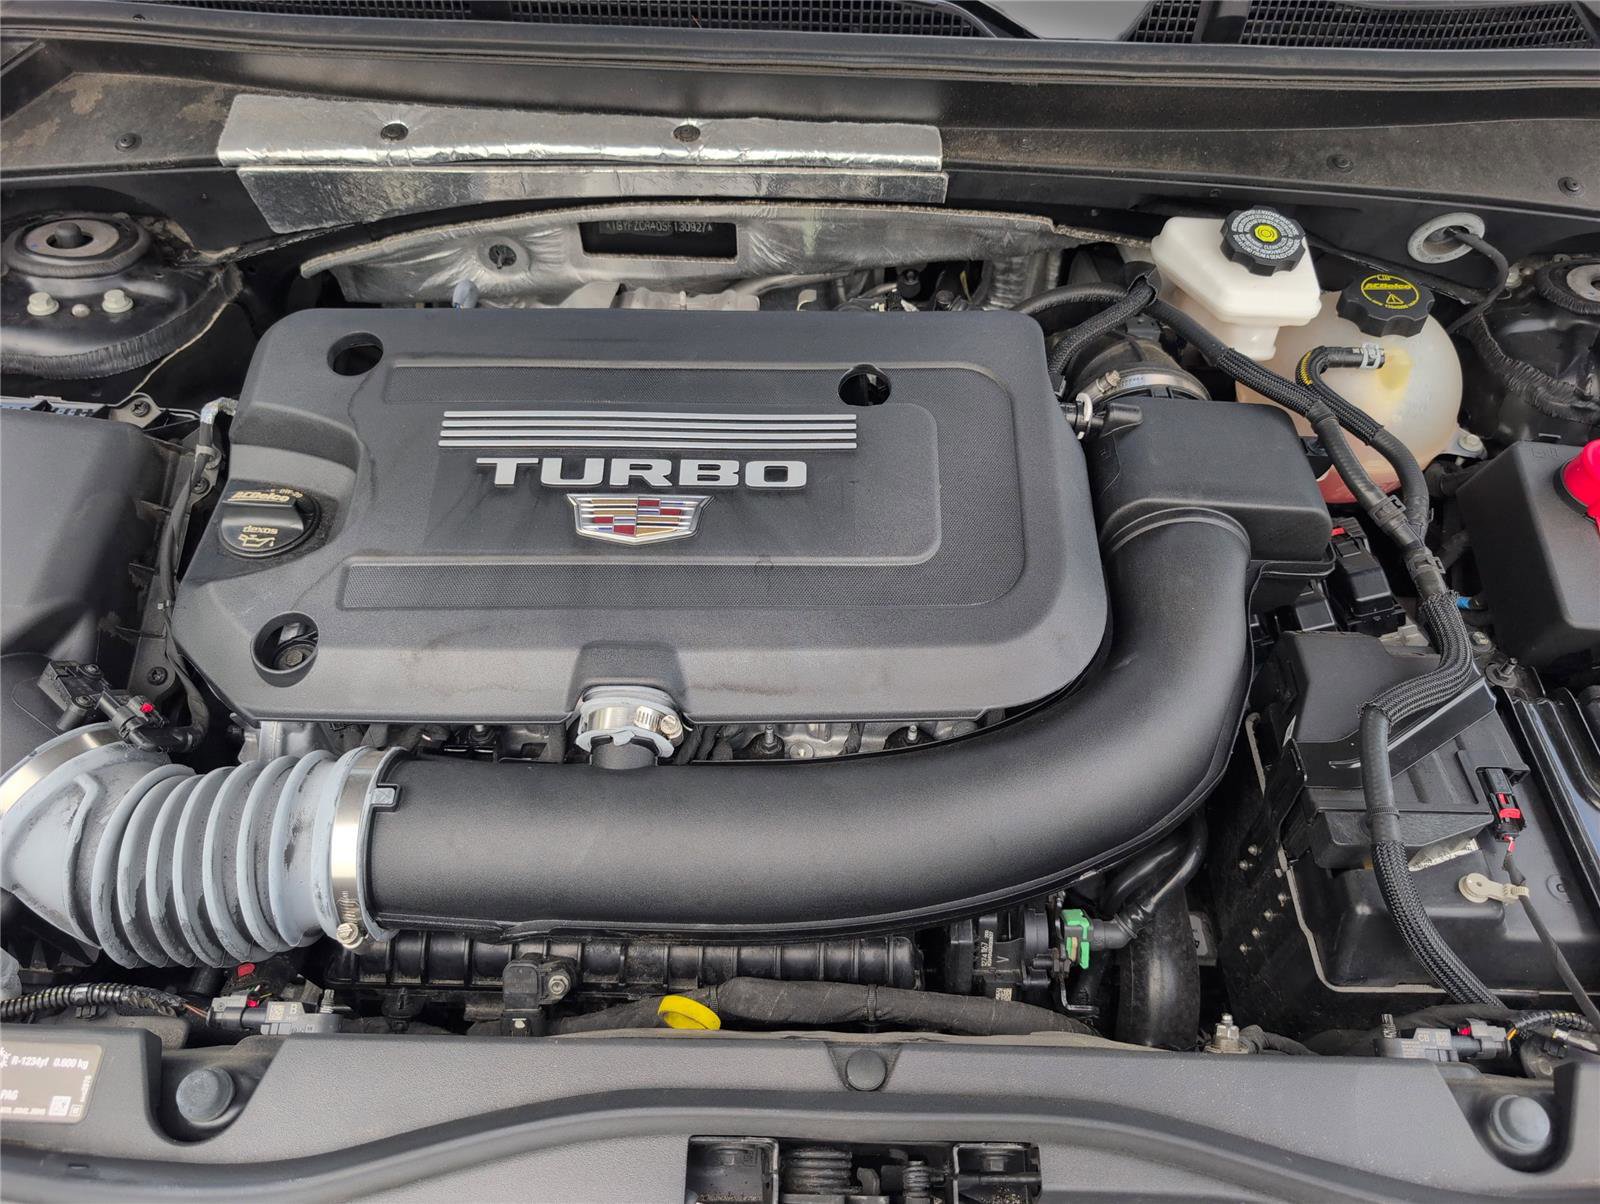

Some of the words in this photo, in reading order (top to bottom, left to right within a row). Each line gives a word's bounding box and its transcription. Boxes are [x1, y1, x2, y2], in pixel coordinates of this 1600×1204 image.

[476, 457, 807, 488] TURBO
[230, 491, 290, 502] ACDelco
[242, 525, 278, 535] dexos
[11, 1055, 49, 1068] R-1234yf
